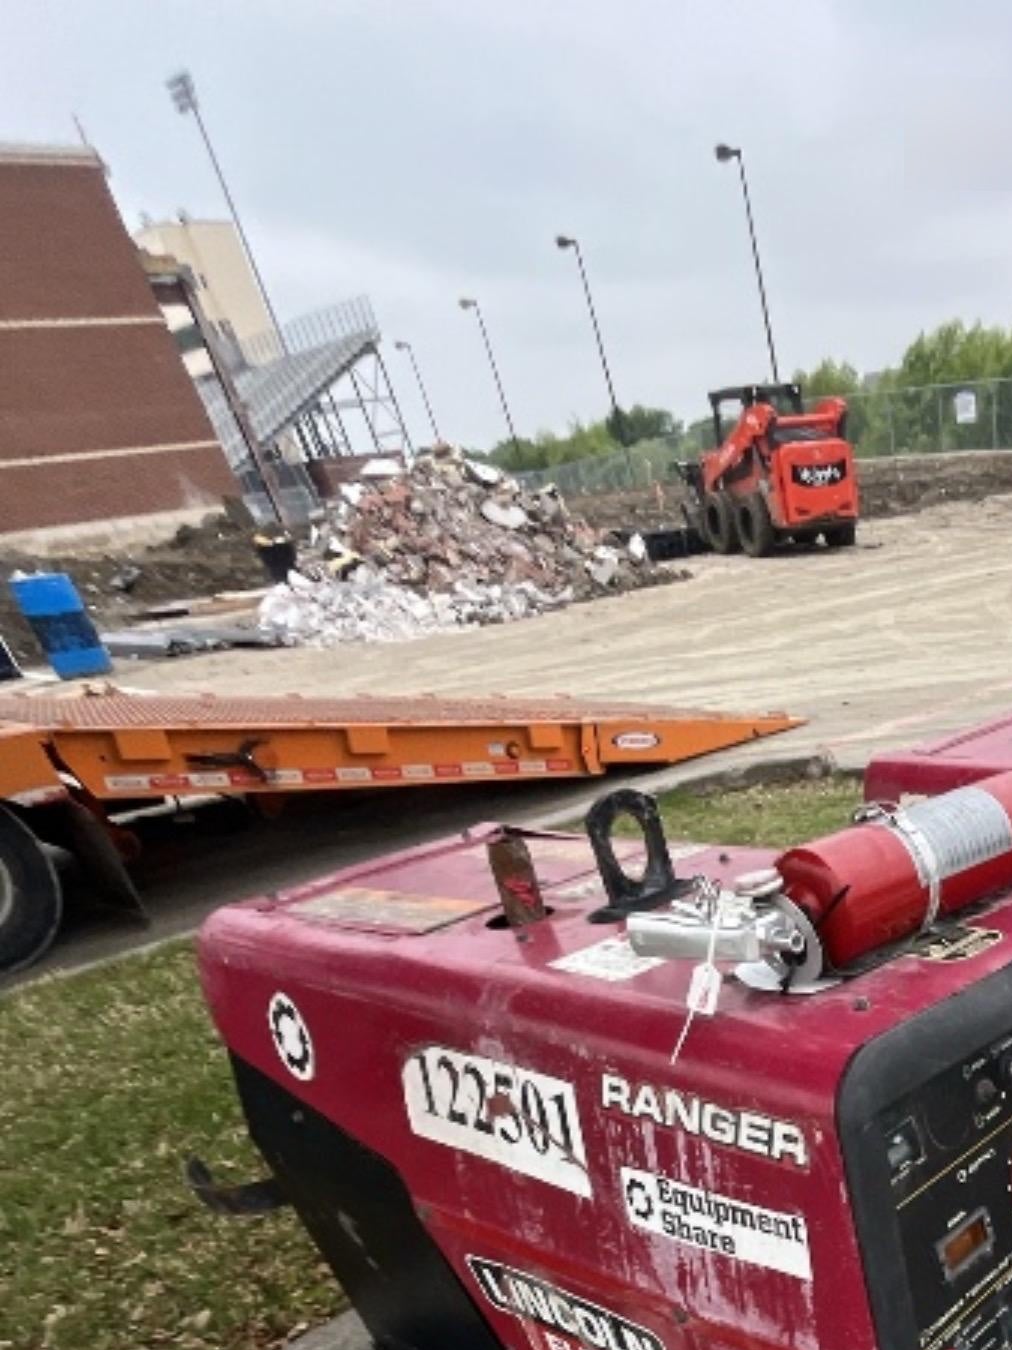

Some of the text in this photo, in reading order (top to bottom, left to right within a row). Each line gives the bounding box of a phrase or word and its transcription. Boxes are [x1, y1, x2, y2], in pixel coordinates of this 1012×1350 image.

[412, 1055, 578, 1163] 122501
[601, 1072, 808, 1166] RANGER
[656, 1178, 804, 1243] Equipment
[661, 1210, 737, 1255] Share
